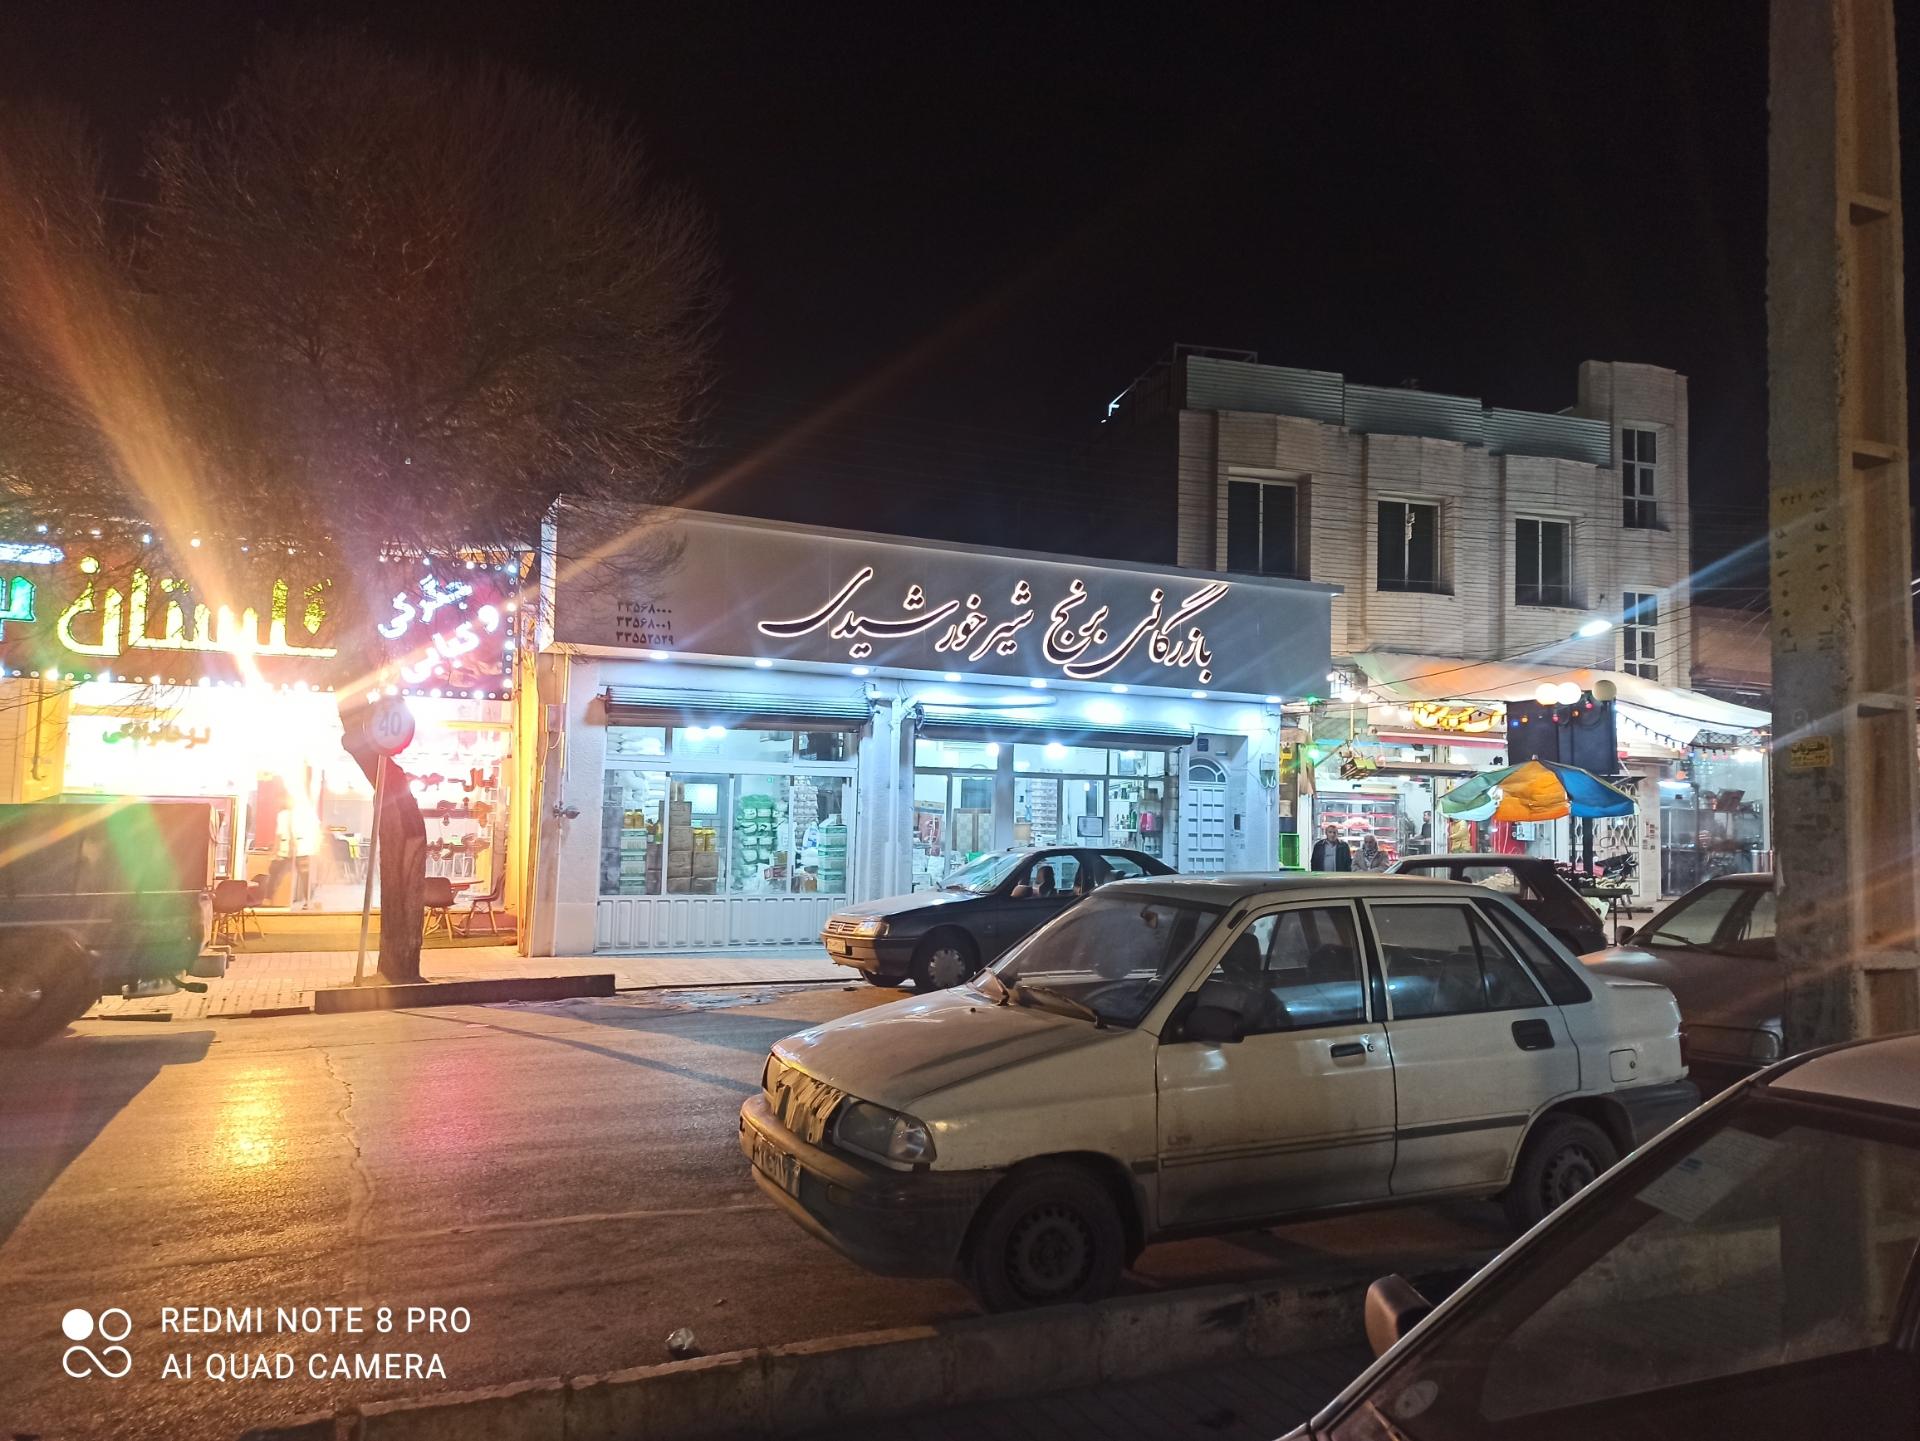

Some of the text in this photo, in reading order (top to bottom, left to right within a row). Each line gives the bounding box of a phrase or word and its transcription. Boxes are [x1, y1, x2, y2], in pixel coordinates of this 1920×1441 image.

[400, 621, 480, 684] کبابی
[757, 566, 1230, 684] بازرگانی برنج شیر خورشیدی
[378, 711, 401, 737] 40
